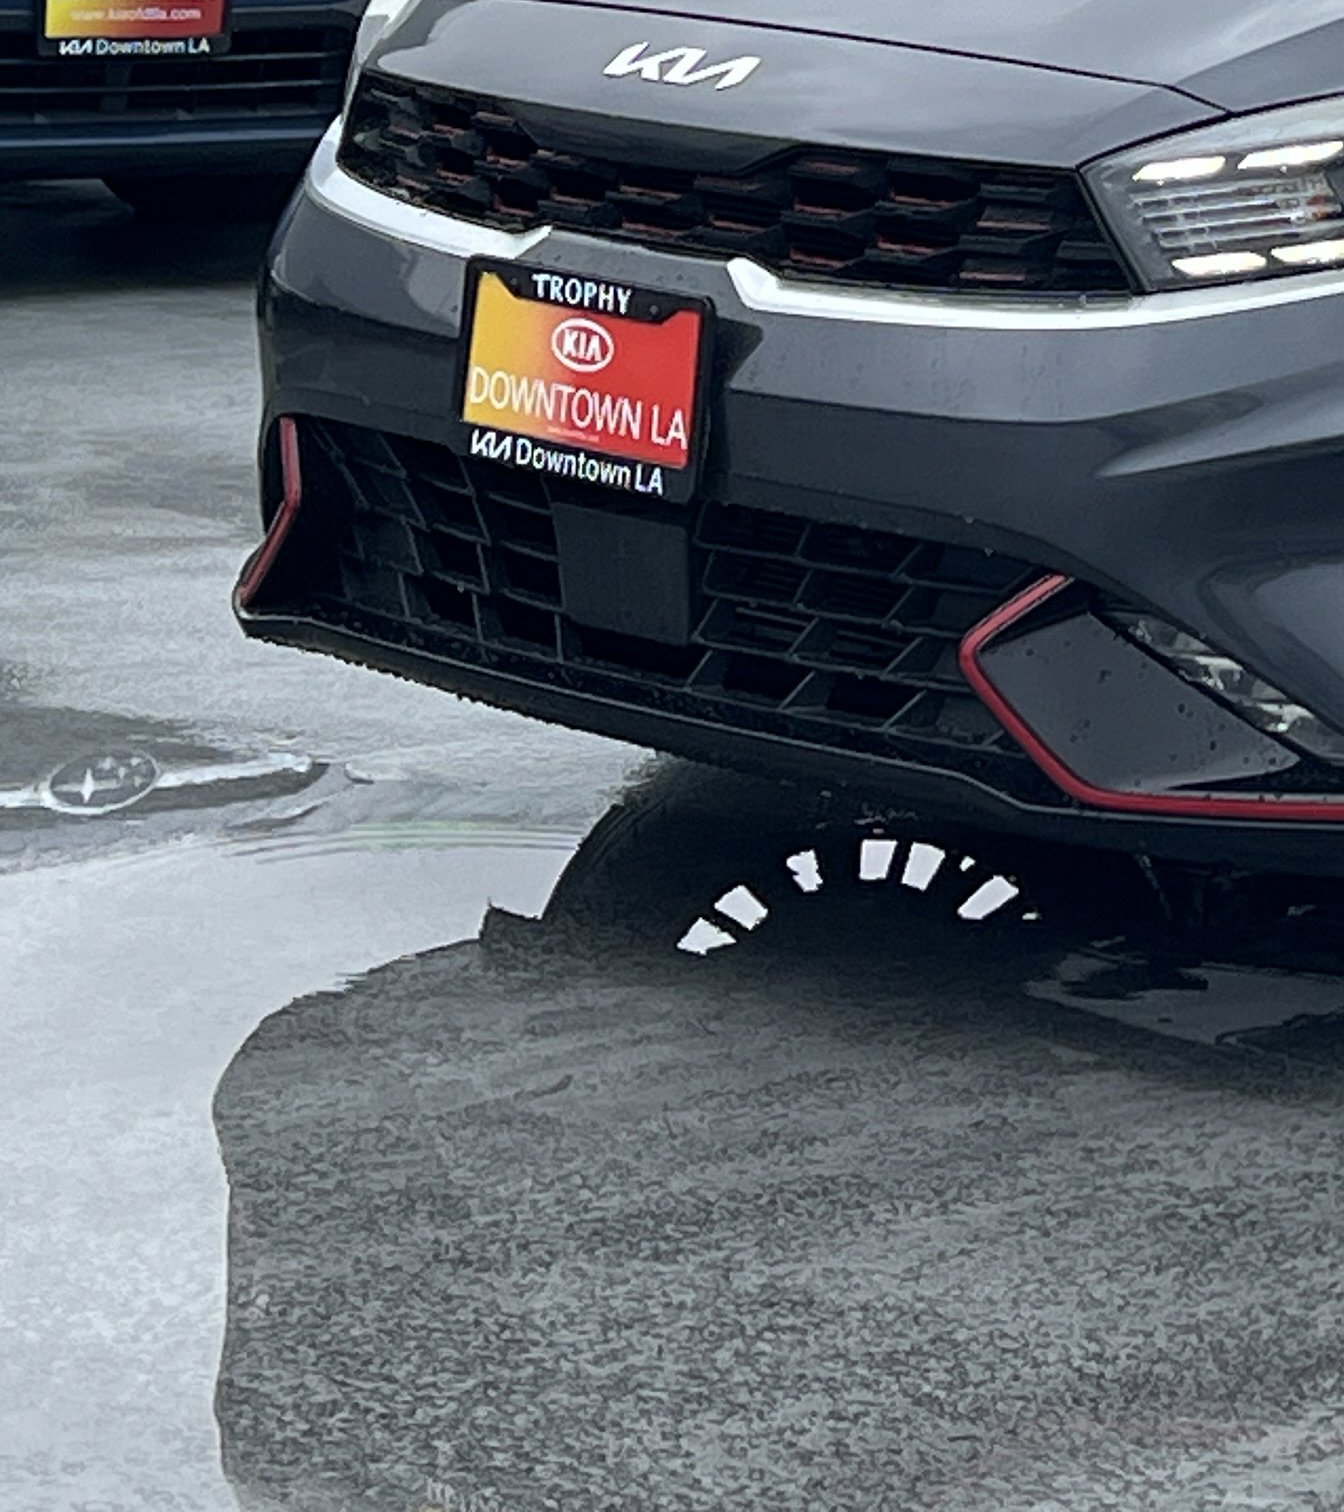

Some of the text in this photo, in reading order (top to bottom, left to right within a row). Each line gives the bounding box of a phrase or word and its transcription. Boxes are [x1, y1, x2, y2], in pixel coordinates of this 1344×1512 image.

[96, 39, 186, 55] Downtown
[187, 38, 211, 54] LA
[602, 41, 763, 92] KIA
[531, 272, 633, 315] TROPHY
[561, 327, 603, 363] KIA
[468, 365, 689, 451] DOWNTOWN LA
[470, 428, 511, 461] KIA
[515, 437, 631, 489] Downtown
[634, 462, 664, 497] LA
